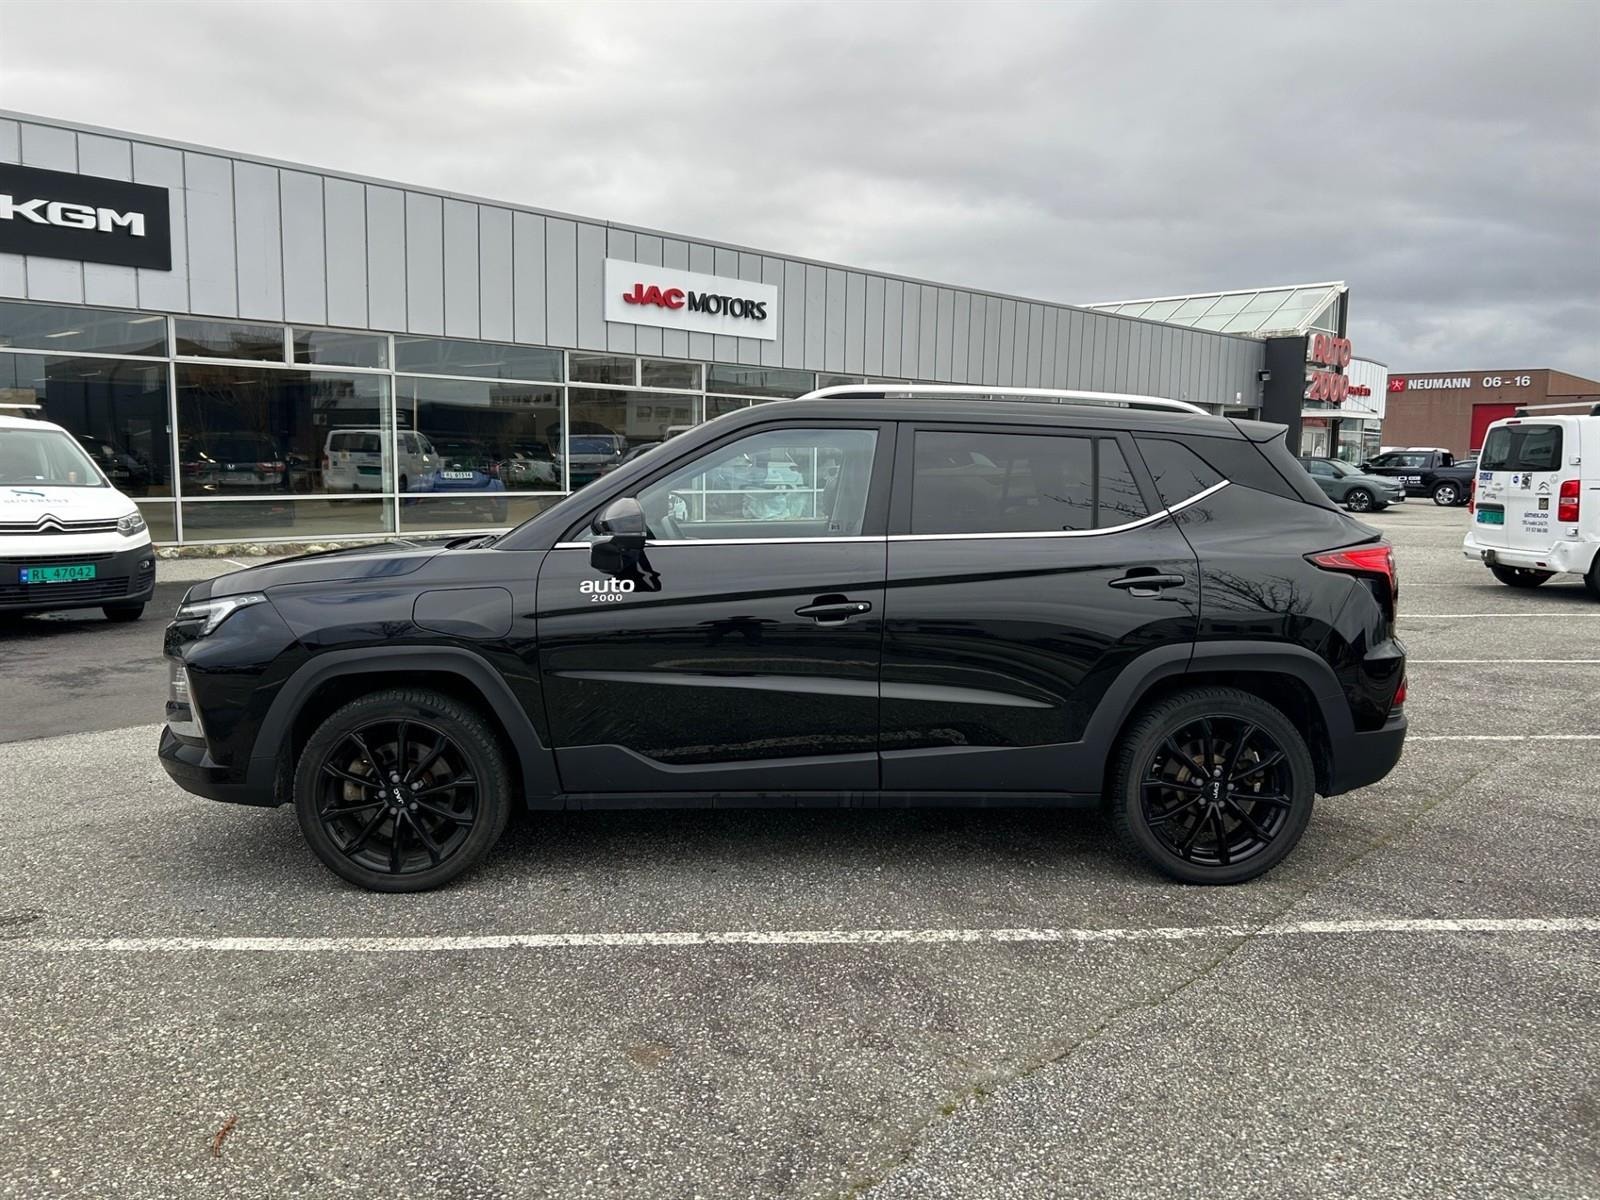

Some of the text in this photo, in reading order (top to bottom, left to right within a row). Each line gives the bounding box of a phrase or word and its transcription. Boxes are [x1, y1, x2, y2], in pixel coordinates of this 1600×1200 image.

[0, 194, 146, 236] KGM
[623, 283, 767, 320] JAC MOTORS
[1310, 333, 1352, 368] AUTO
[1309, 371, 1349, 403] 2000
[1408, 377, 1471, 390] NEUMANN
[1482, 376, 1502, 388] 06
[1514, 375, 1531, 387] 16
[54, 567, 91, 578] 47042
[580, 577, 635, 594] auto
[591, 594, 623, 602] 2000
